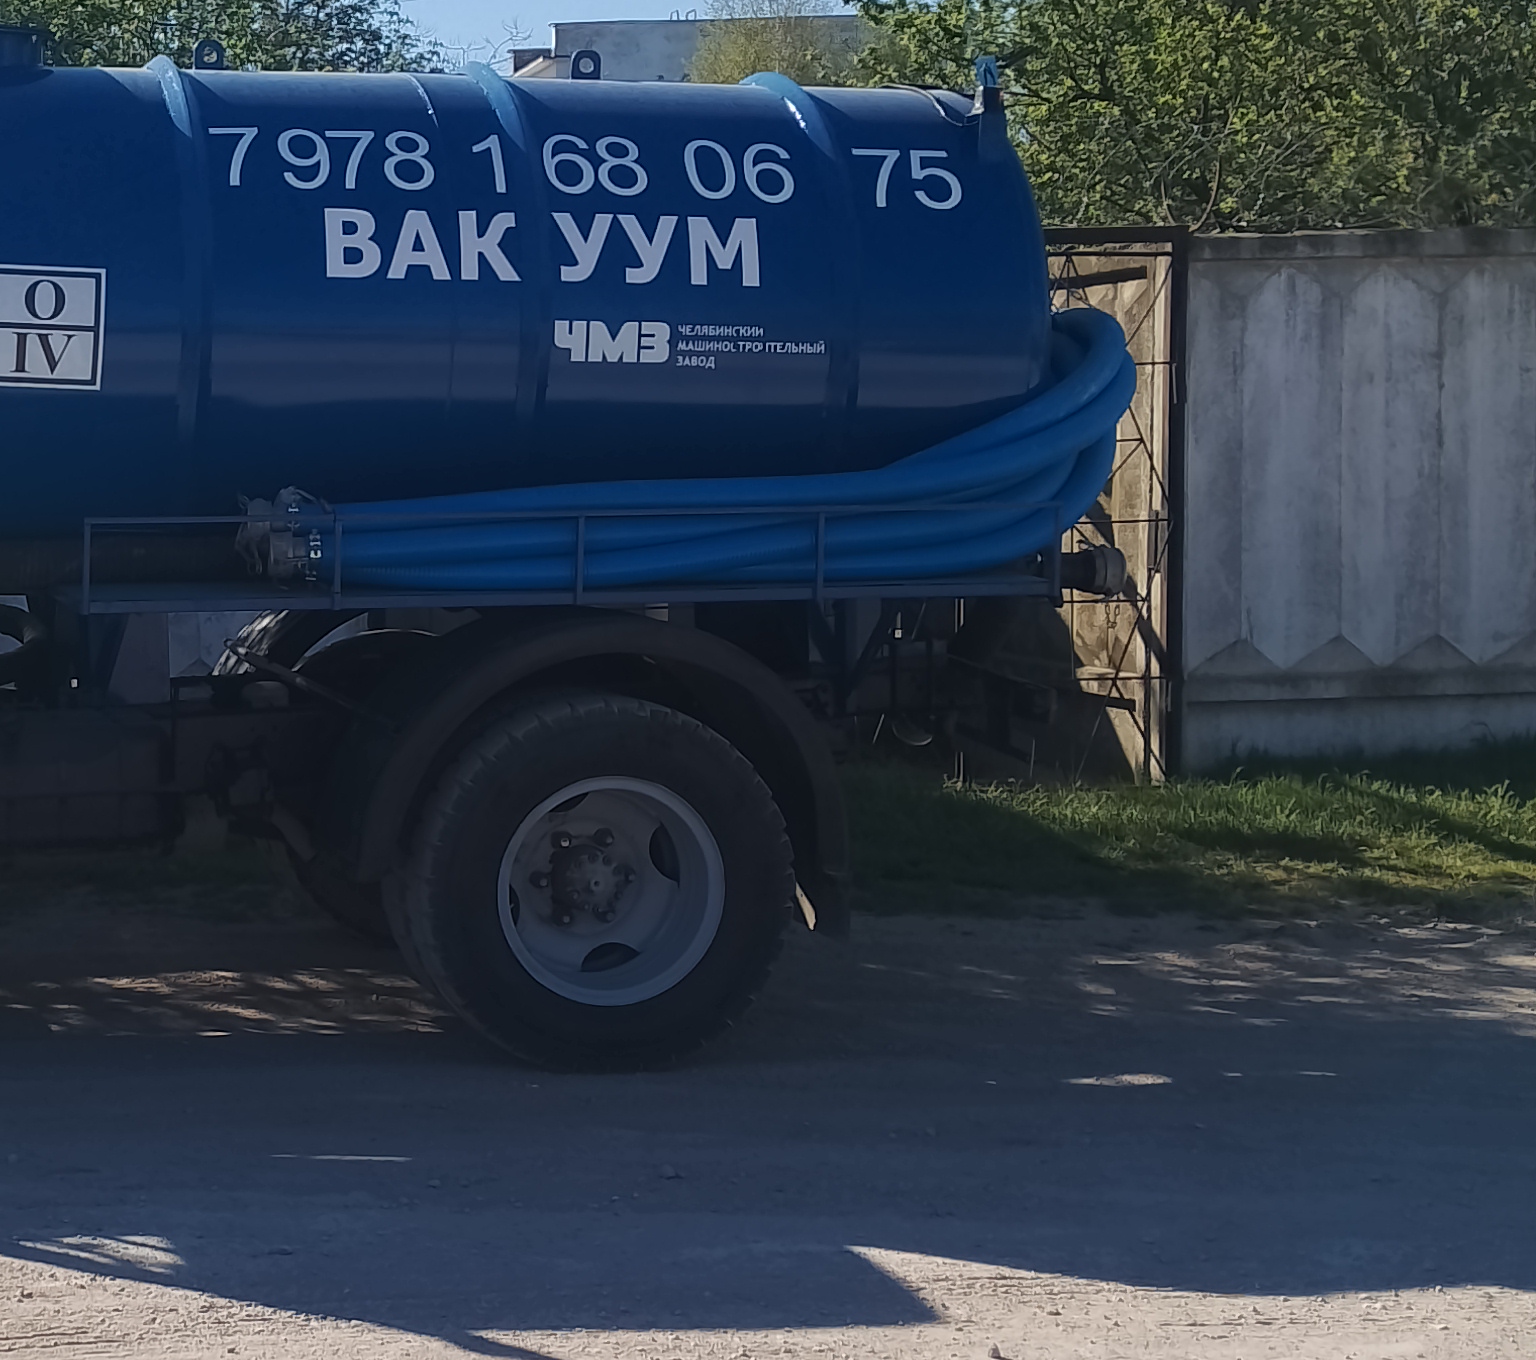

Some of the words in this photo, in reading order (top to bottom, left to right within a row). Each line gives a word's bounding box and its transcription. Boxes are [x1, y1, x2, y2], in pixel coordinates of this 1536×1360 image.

[208, 127, 259, 187] 7
[277, 128, 435, 191] 978
[472, 134, 507, 194] 1
[543, 134, 648, 197] 68
[684, 139, 795, 204] 06
[852, 148, 962, 210] 75
[324, 207, 521, 282] ВАК
[551, 212, 761, 287] УУМ
[10, 331, 77, 375] IV
[676, 355, 716, 369] ЗАВОД
